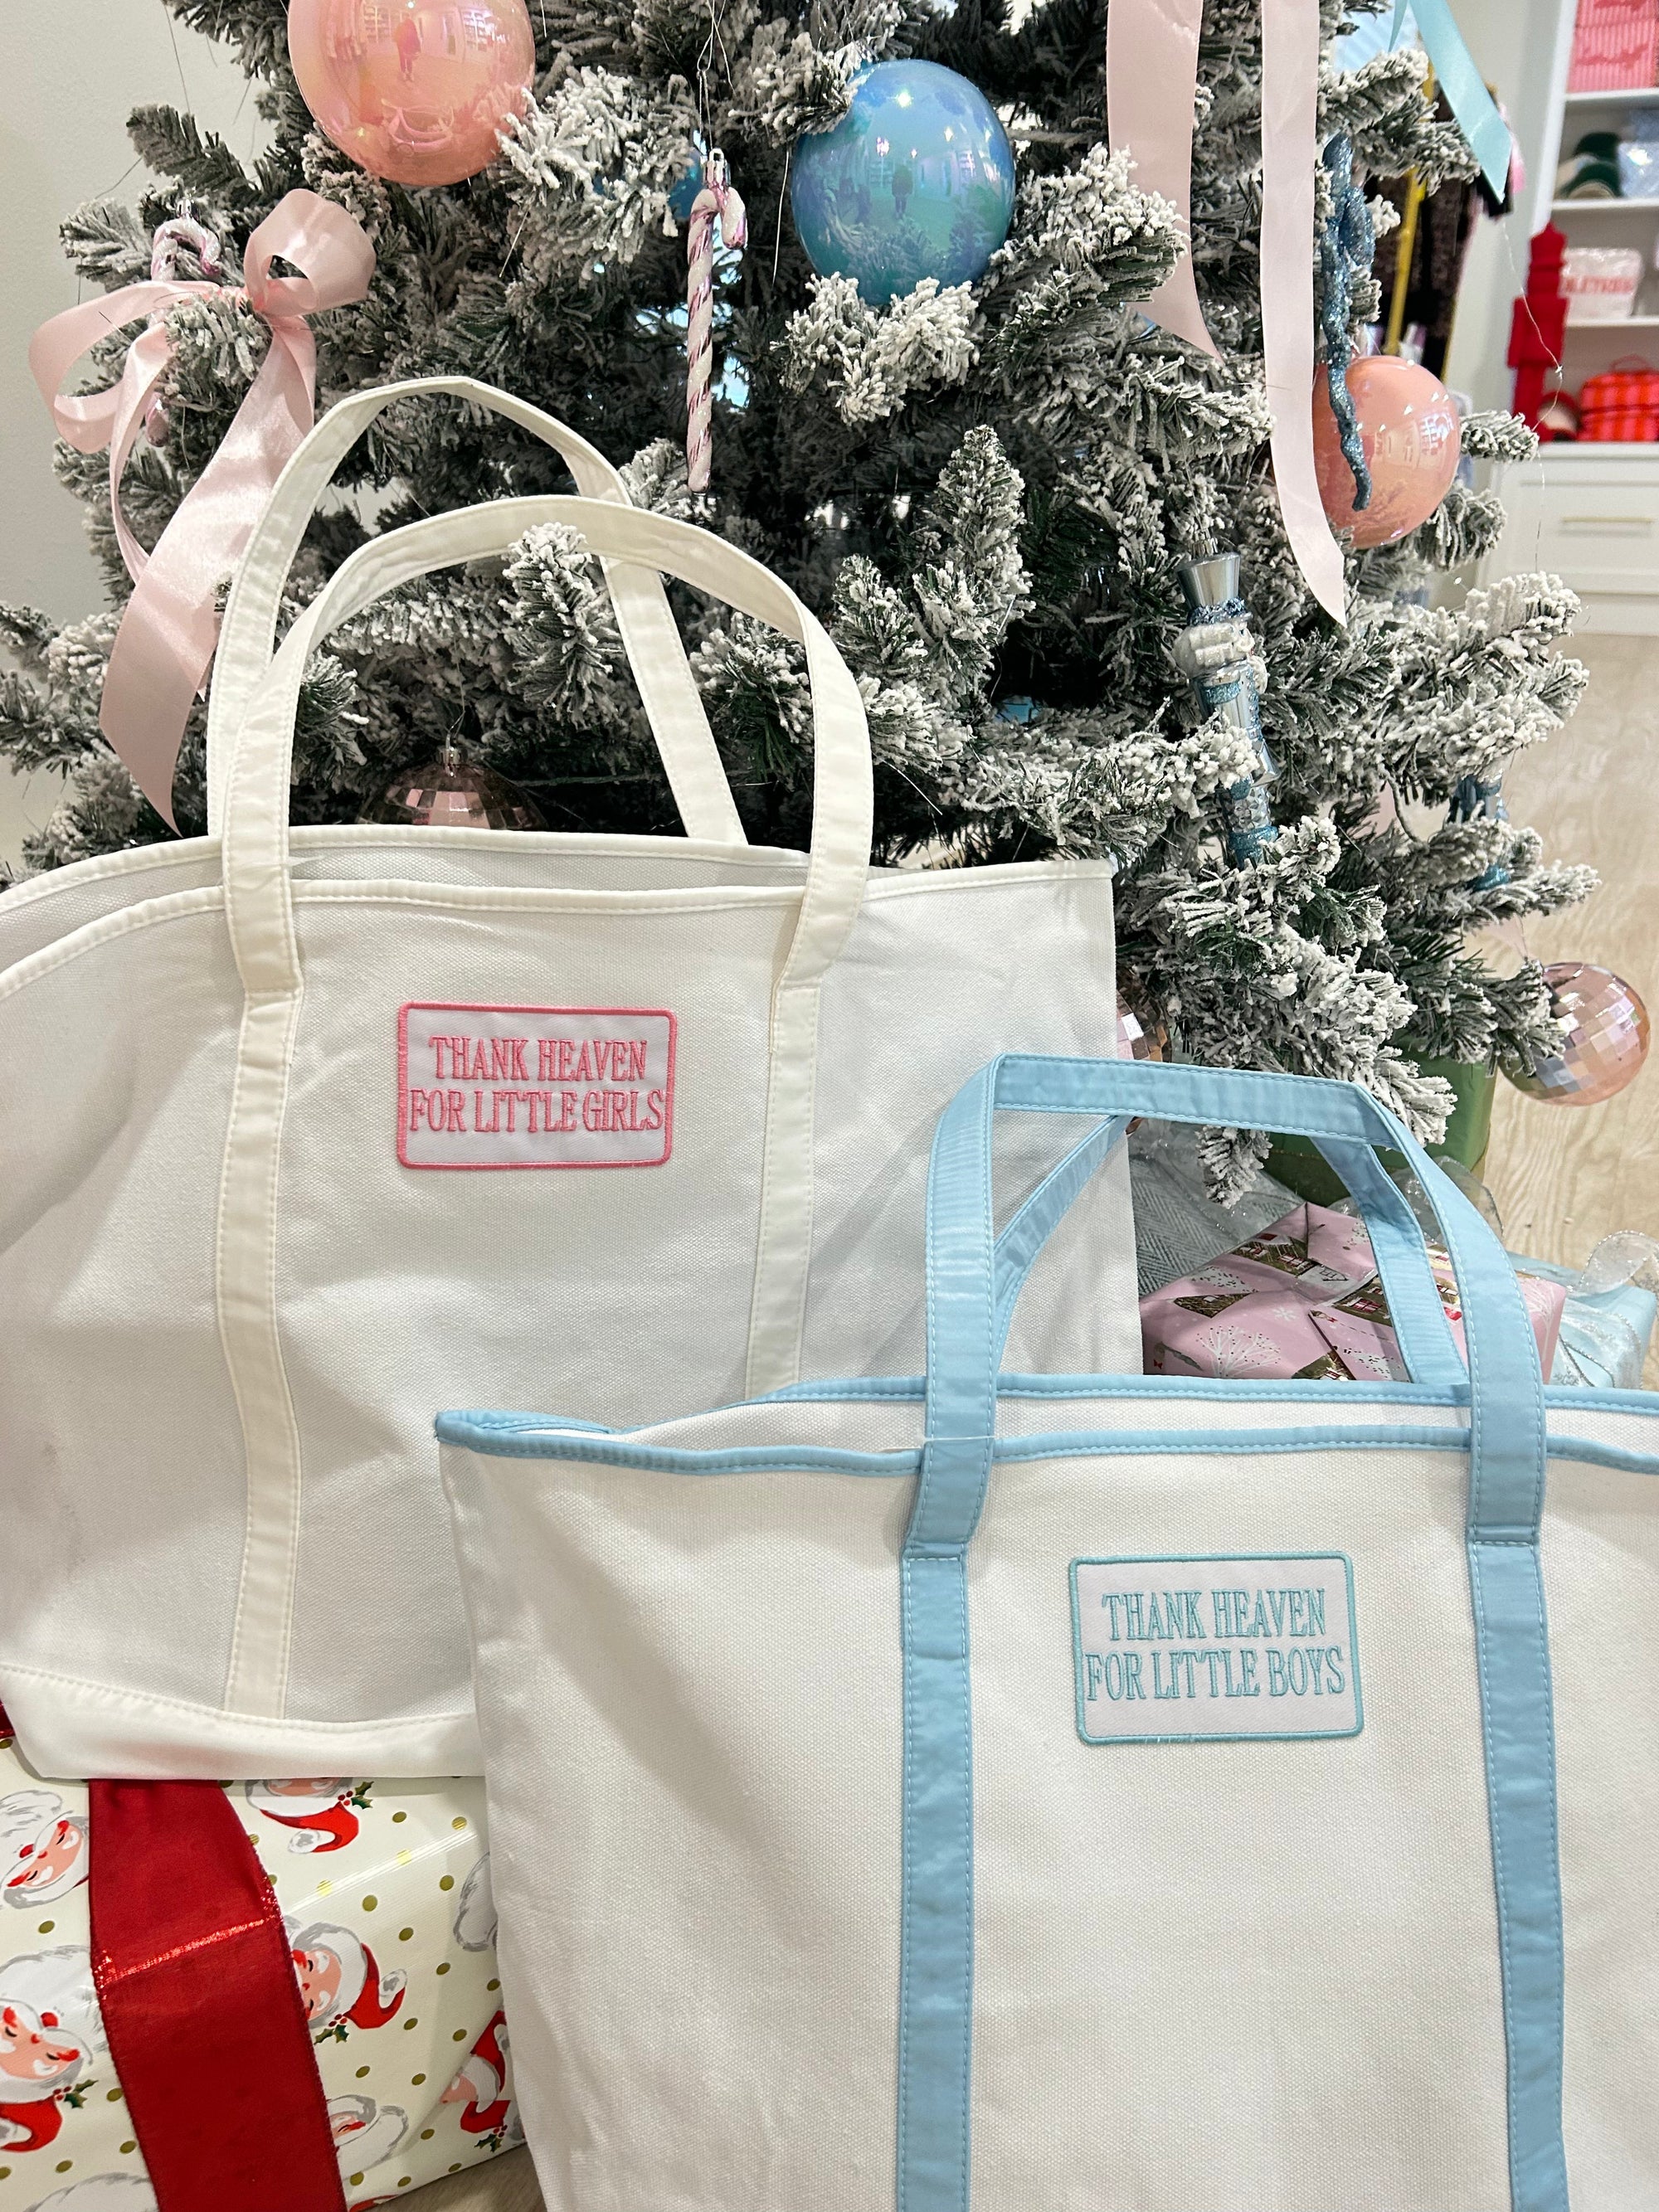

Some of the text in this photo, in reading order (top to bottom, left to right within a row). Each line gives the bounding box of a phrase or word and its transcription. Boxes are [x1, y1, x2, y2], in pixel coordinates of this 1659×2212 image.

[430, 1036, 647, 1082] THANK HEAVEN
[410, 1089, 664, 1133] FOR LITTLE GIRLS
[1102, 1588, 1326, 1641] THANK HEAVEN
[1084, 1646, 1345, 1700] FOR LITTLE BOYS
